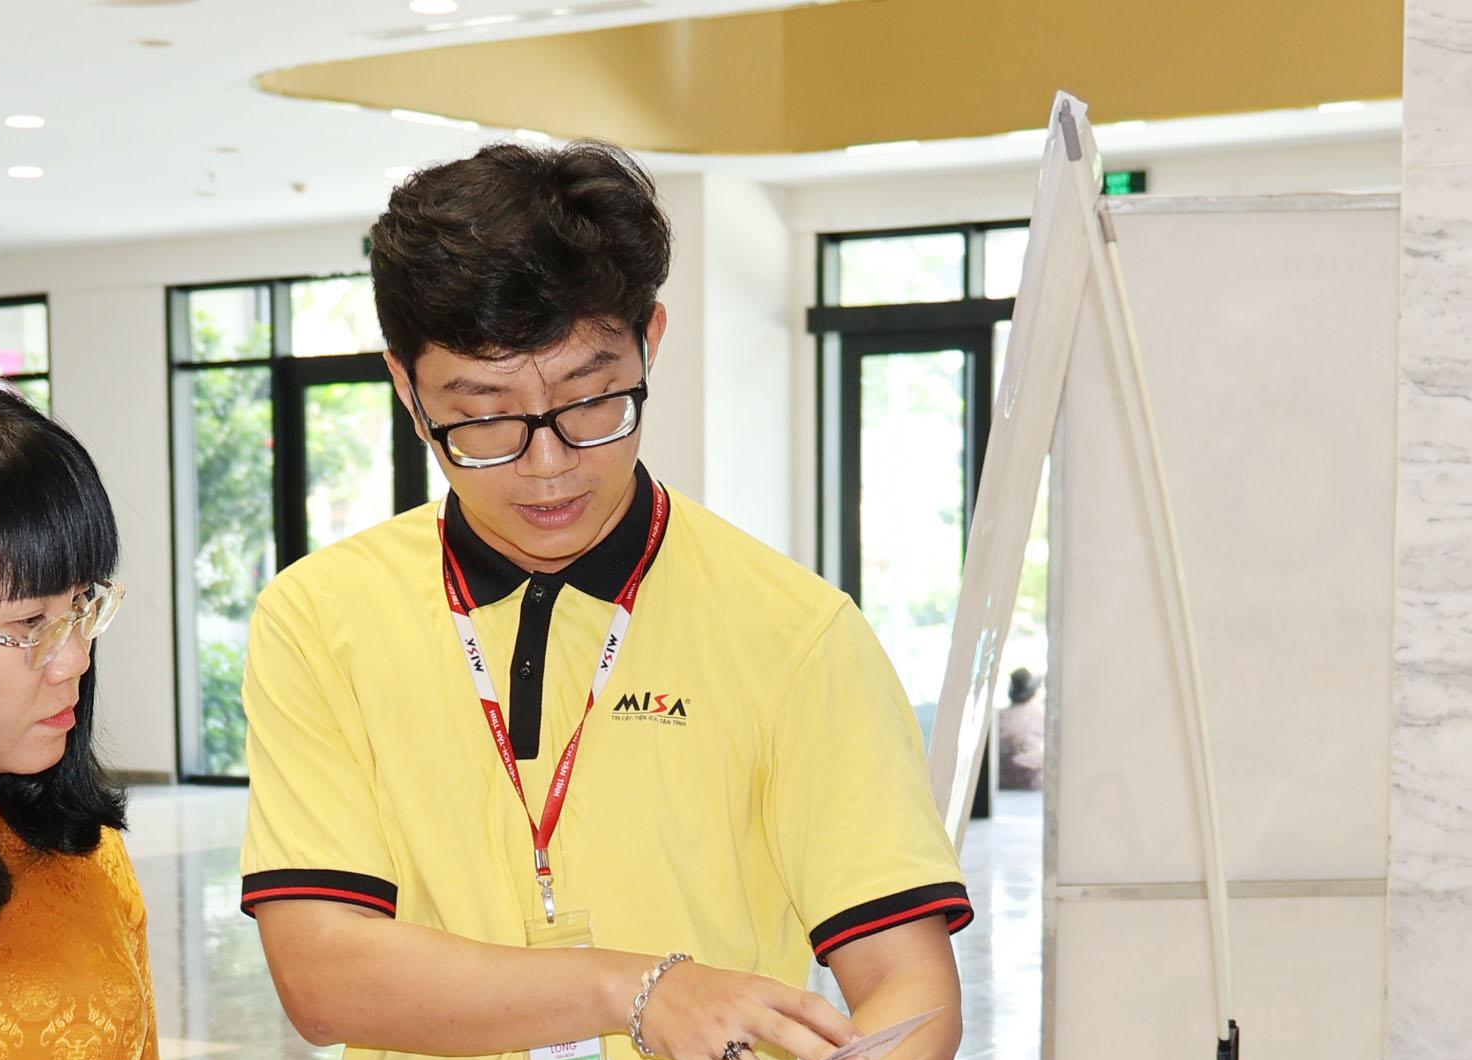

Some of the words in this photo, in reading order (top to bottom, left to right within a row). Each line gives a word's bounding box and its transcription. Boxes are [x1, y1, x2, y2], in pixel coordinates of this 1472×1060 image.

[466, 638, 484, 672] MISA
[600, 633, 619, 669] MISA
[613, 692, 688, 717] MISA
